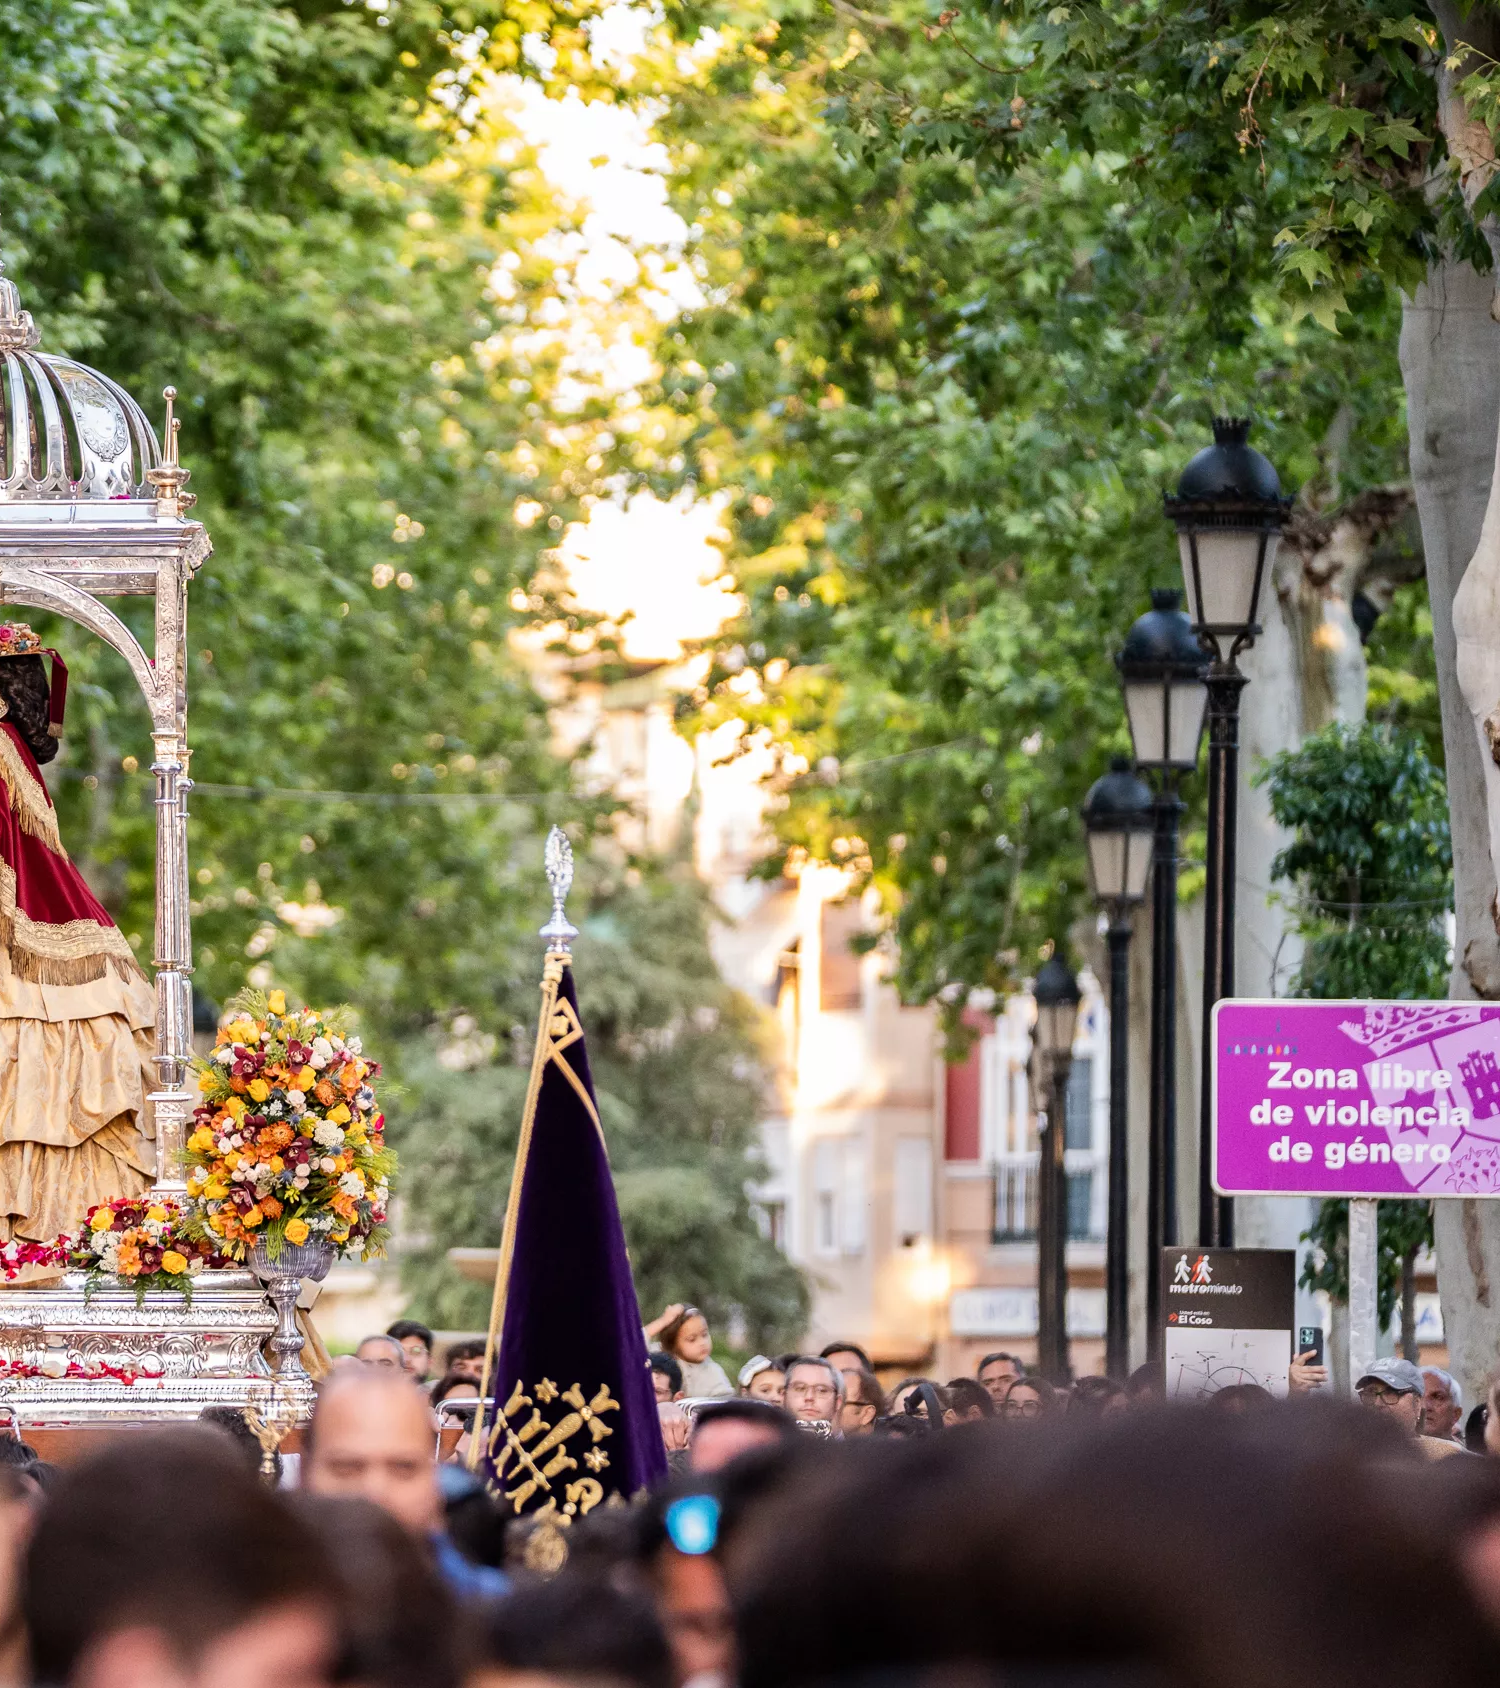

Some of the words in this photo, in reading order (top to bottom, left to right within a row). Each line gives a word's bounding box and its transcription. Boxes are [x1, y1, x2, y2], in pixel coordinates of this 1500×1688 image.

[1267, 1061, 1358, 1089] Zona
[1371, 1063, 1453, 1089] libre
[1249, 1098, 1294, 1126] de
[1304, 1099, 1470, 1127] violencia
[1268, 1135, 1313, 1163] de
[1324, 1136, 1451, 1169] género
[1178, 1315, 1188, 1324] El
[1189, 1315, 1213, 1325] Coso
